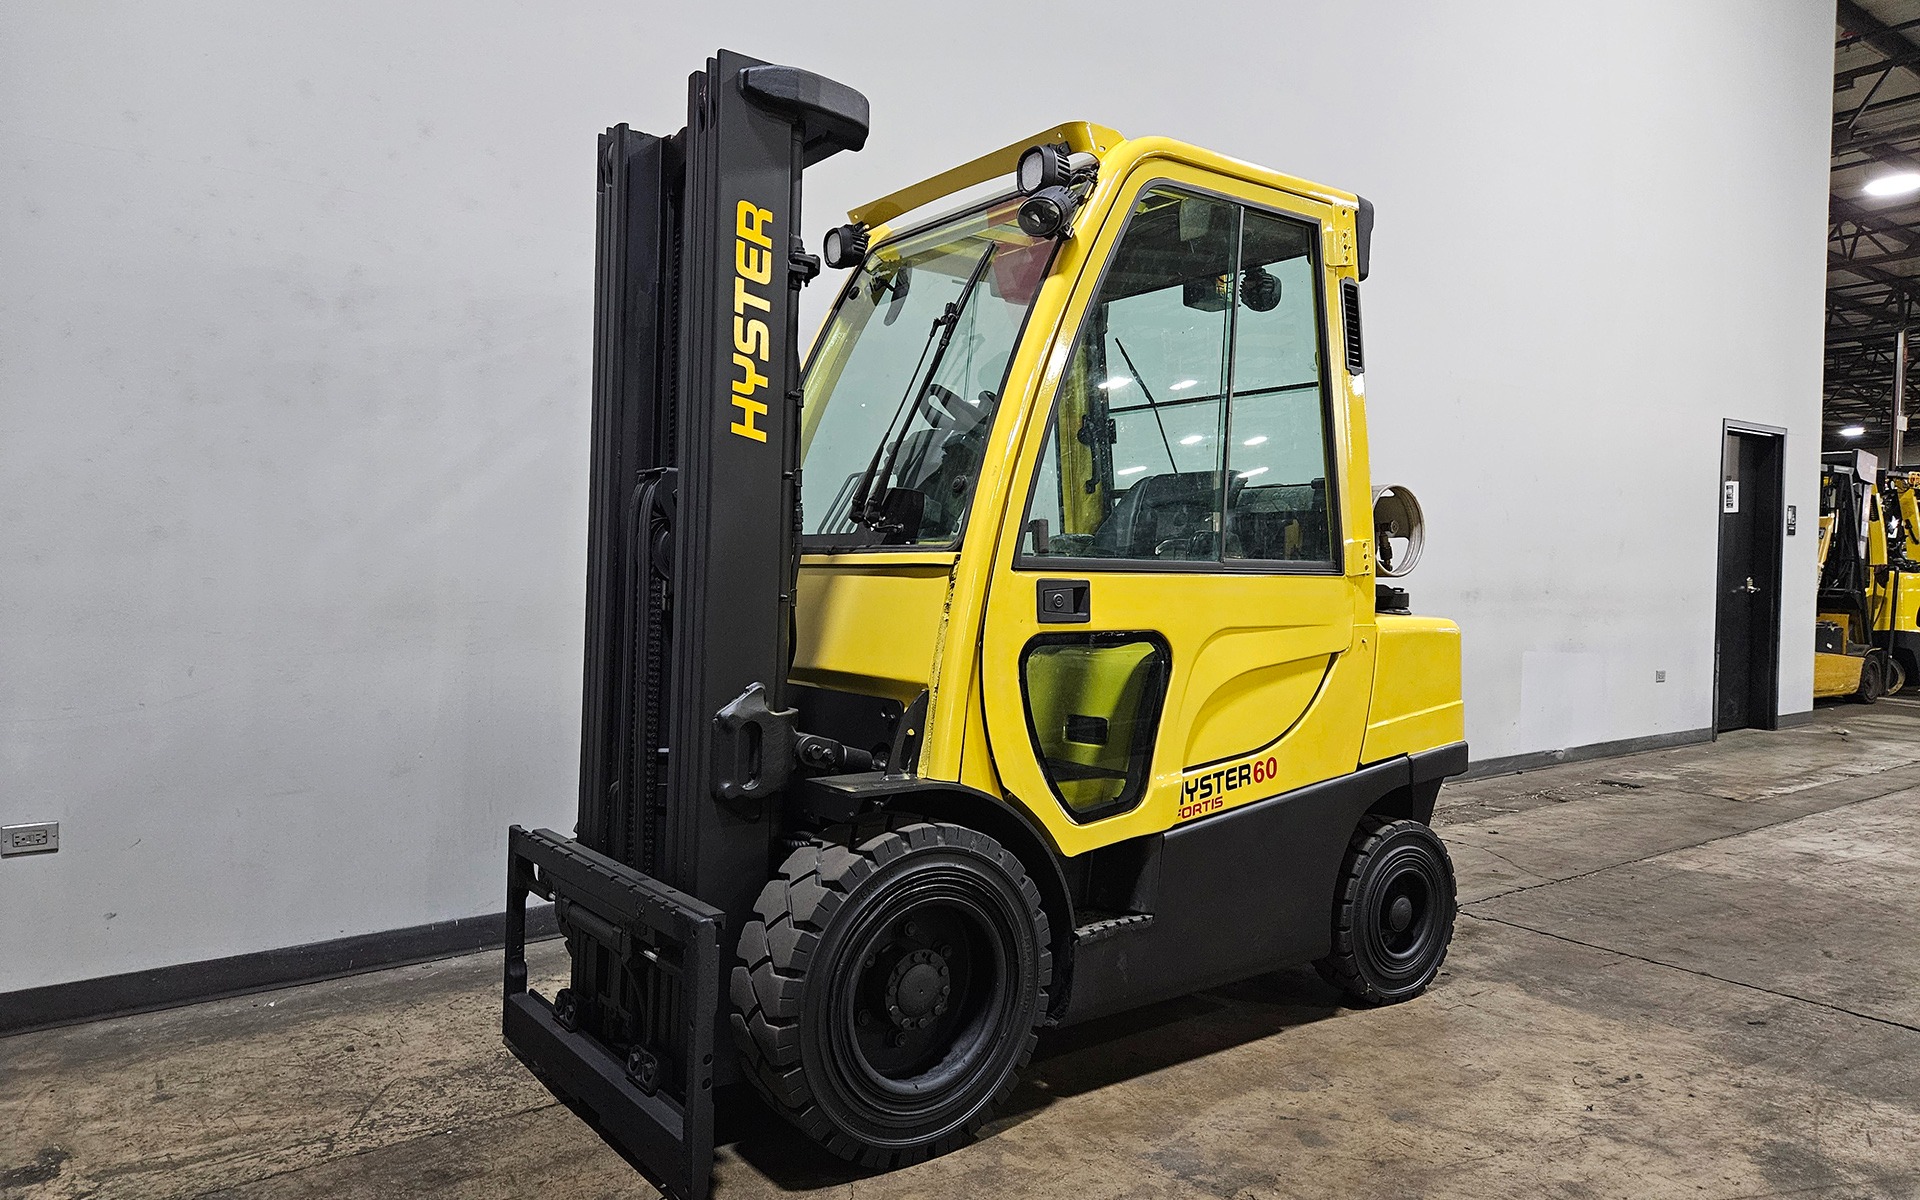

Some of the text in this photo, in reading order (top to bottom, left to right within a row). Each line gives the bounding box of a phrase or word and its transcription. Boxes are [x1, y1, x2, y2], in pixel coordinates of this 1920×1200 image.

[730, 199, 773, 443] HYSTER
[1180, 756, 1278, 805] YSTER 60
[1178, 796, 1223, 819] ORTIS
